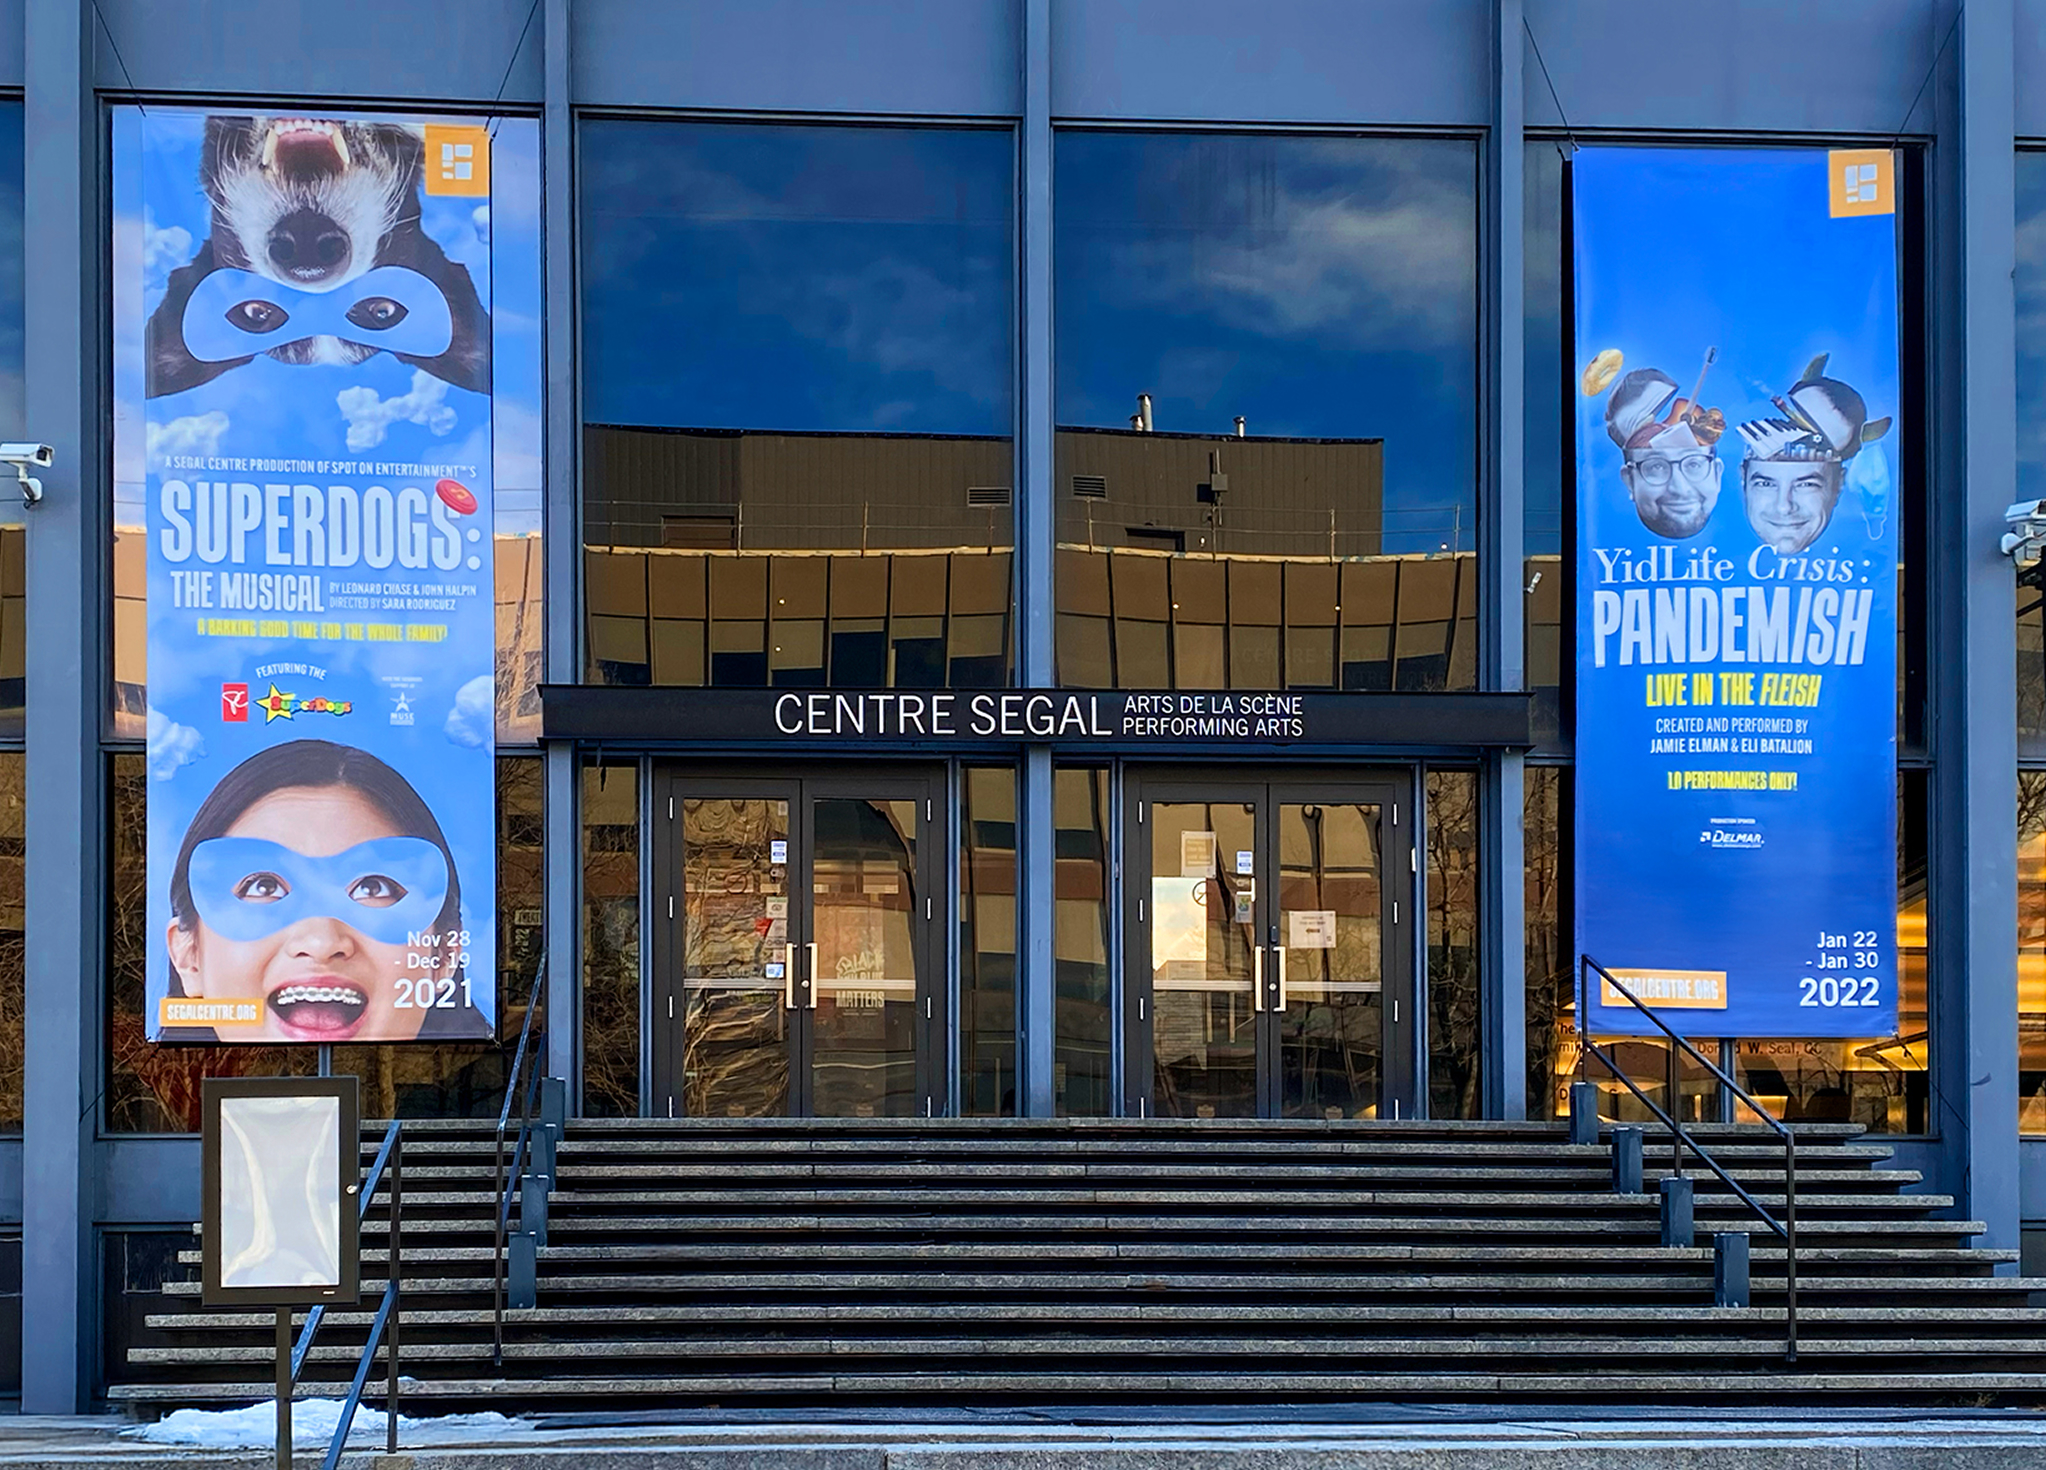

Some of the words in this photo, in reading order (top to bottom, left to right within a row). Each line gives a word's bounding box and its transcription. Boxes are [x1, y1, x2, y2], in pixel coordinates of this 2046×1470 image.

[165, 455, 171, 468] A
[174, 456, 206, 470] SEGAL
[208, 457, 248, 471] CENTRE
[250, 458, 315, 473] PRODUCTION
[317, 460, 330, 474] OF
[331, 461, 357, 475] SPOT
[359, 462, 374, 475] ON
[160, 479, 481, 571] SUPERDOGS:
[1593, 545, 1735, 584] YidLife
[170, 571, 213, 608] THE
[220, 572, 325, 612] MUSICAL
[329, 582, 340, 594] BY
[341, 582, 382, 595] LEONARD
[383, 583, 412, 596] CHASE
[413, 584, 420, 596] &
[421, 584, 443, 596] JOHN
[445, 584, 476, 597] HALPIN
[329, 596, 369, 609] DIRECTED
[382, 598, 405, 610] SARA
[1593, 586, 1874, 668] PANDEMISH
[255, 662, 307, 679] FEATURING
[308, 665, 327, 681] THE
[1646, 673, 1688, 707] LIVE
[1692, 673, 1714, 706] IN
[1719, 672, 1755, 706] THE
[1759, 673, 1823, 707] FLEISH
[1124, 695, 1174, 714] ARTS
[1180, 695, 1206, 714] DE
[1211, 695, 1234, 714] LA
[1239, 693, 1303, 715] SCÈNE
[774, 693, 956, 735] CENTRE
[970, 694, 1113, 736] SEGAL
[1122, 717, 1249, 737] PERFORMING
[1254, 718, 1303, 737] ARTS
[1656, 717, 1704, 733] CREATED
[1706, 717, 1729, 733] AND
[1731, 718, 1793, 734] PERFORMED
[1795, 719, 1808, 734] BY
[1650, 738, 1685, 754] JAMIE
[1688, 738, 1728, 753] ELMAN
[1731, 738, 1739, 753] &
[1741, 738, 1758, 753] ELI
[1760, 739, 1812, 754] BATALION
[1684, 771, 1767, 790] PERFORMANCES
[407, 930, 441, 948] Nov
[447, 930, 471, 947] 28
[1817, 931, 1847, 948] Jan
[1853, 930, 1878, 947] 22
[407, 952, 440, 969] Dec
[448, 952, 471, 969] 19
[1817, 952, 1848, 969] Jan
[1854, 951, 1879, 968] 30
[394, 978, 472, 1009] 2021
[836, 990, 885, 1008] MATTERS
[1799, 976, 1880, 1007] 2022
[167, 1004, 257, 1021] SEGALCENTRE.ORG
